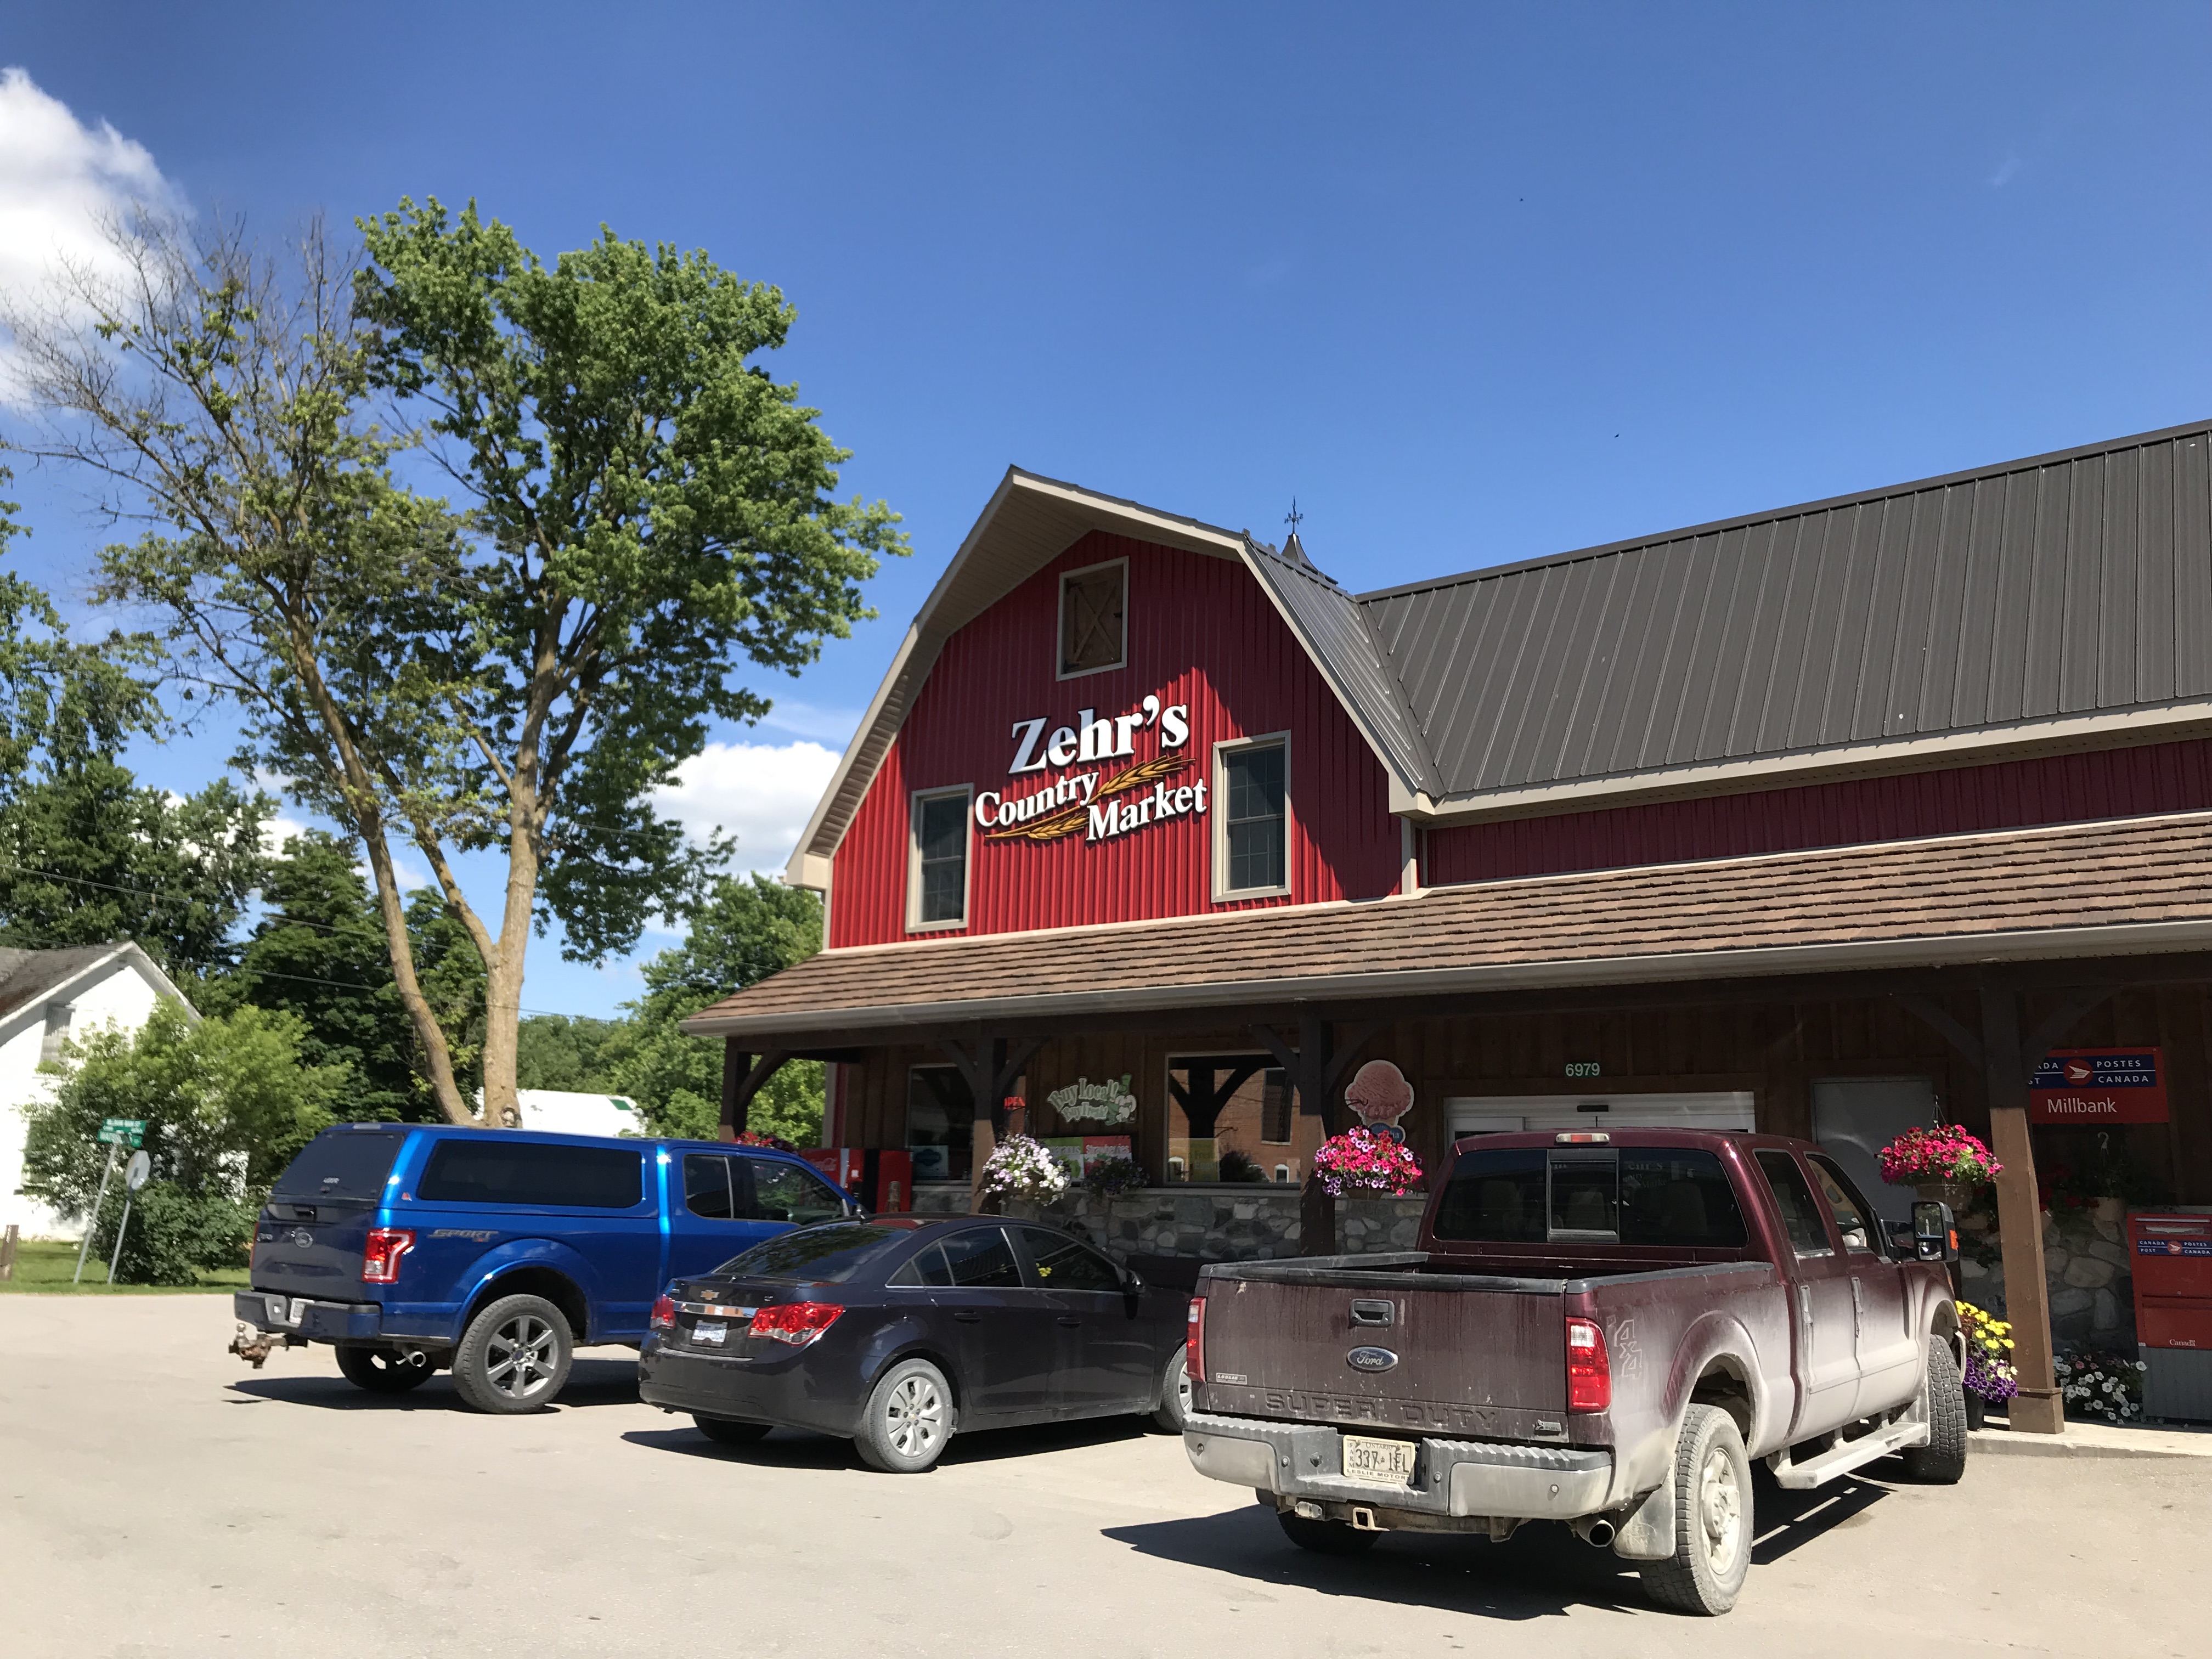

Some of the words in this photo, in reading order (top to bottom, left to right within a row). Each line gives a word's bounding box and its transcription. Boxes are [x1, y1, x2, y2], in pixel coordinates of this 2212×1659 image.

[1008, 695, 1190, 775] Zehr's
[975, 772, 1099, 827] Country
[1086, 778, 1207, 841] Market
[1565, 1063, 1600, 1076] 6979
[2097, 1059, 2141, 1068] POSTES
[2098, 1075, 2149, 1083] CANADA
[1047, 1085, 1079, 1111] Buy
[2047, 1097, 2117, 1113] Millbank
[427, 1229, 500, 1239] SPORT
[1357, 1351, 1384, 1365] Ford
[1266, 1393, 1376, 1419] SUPER
[1402, 1404, 1496, 1430] DUTY
